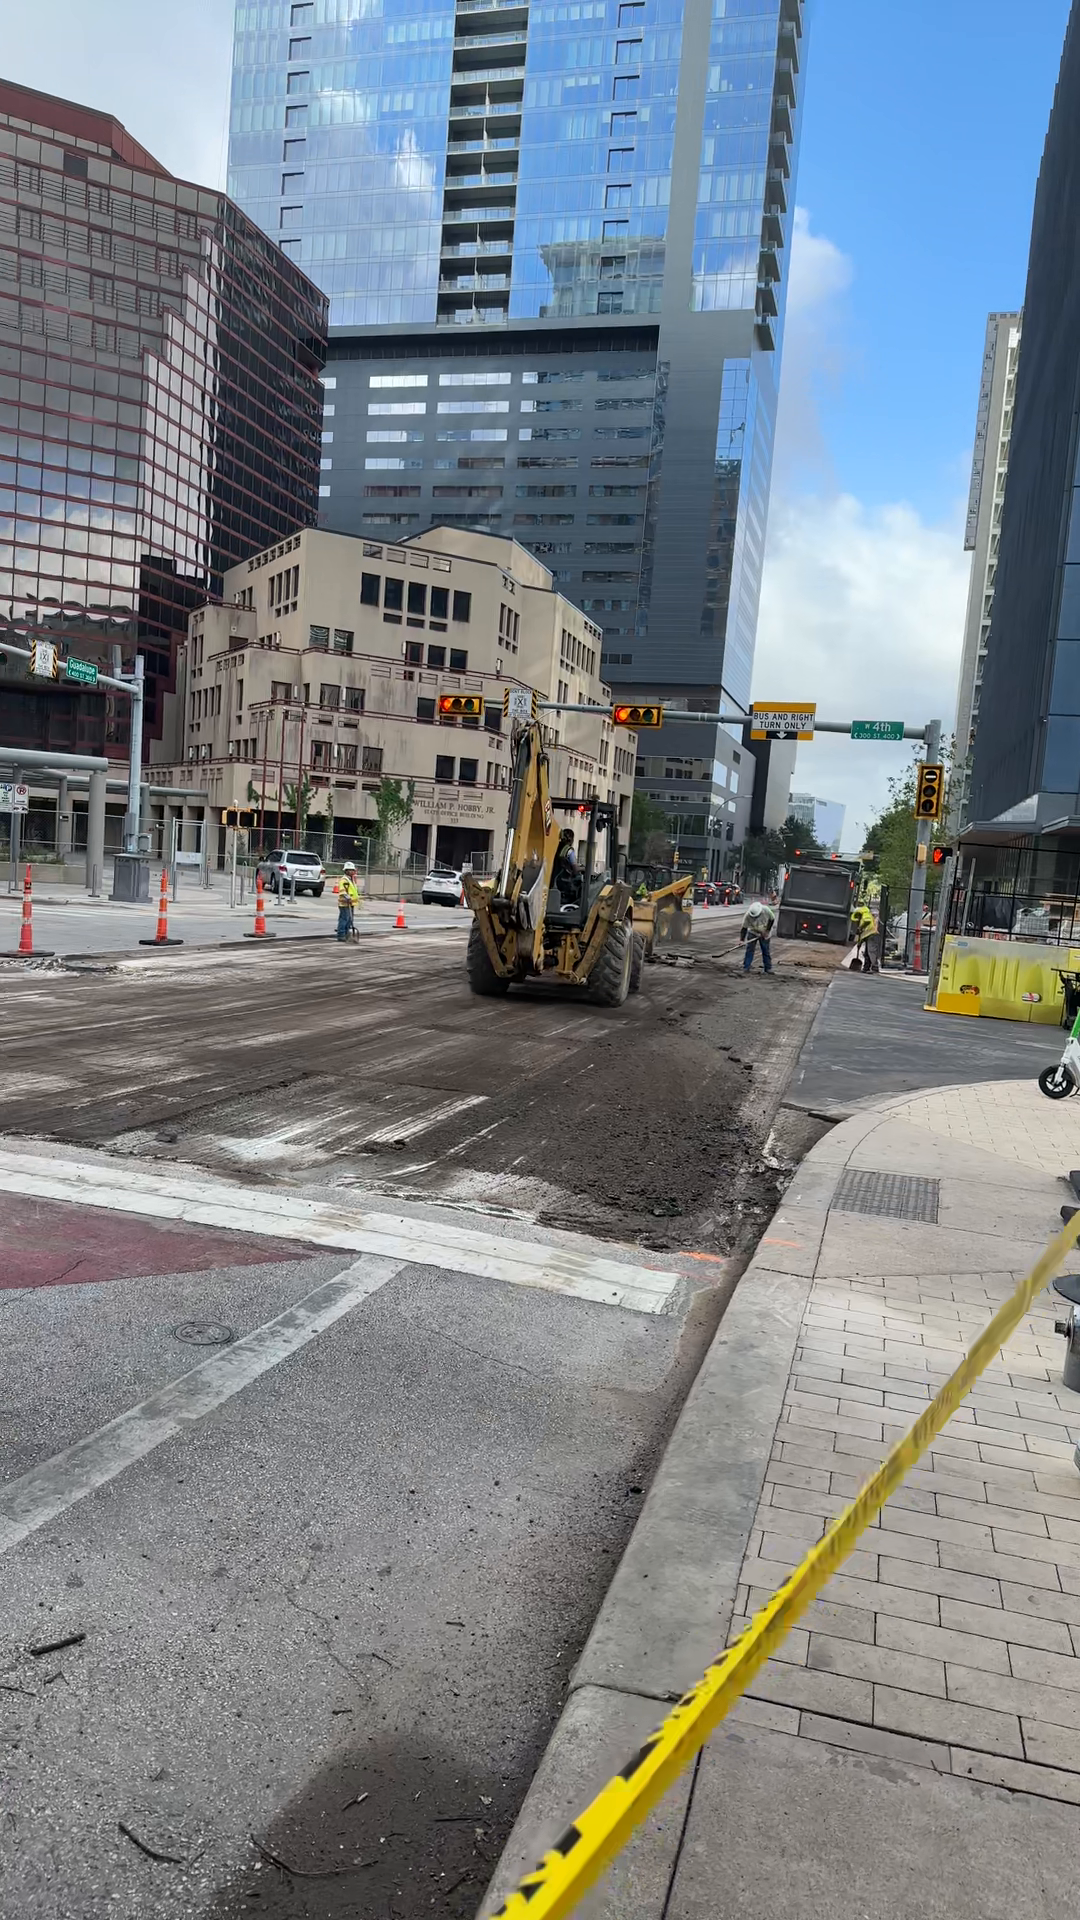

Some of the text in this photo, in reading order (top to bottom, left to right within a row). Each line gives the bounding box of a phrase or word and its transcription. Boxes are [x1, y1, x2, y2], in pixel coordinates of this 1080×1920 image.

[772, 713, 788, 721] AND
[790, 714, 814, 722] RIGHT
[760, 721, 780, 729] TURN
[872, 722, 891, 732] 4th
[414, 800, 446, 810] WILLIAM
[486, 806, 496, 814] JR.
